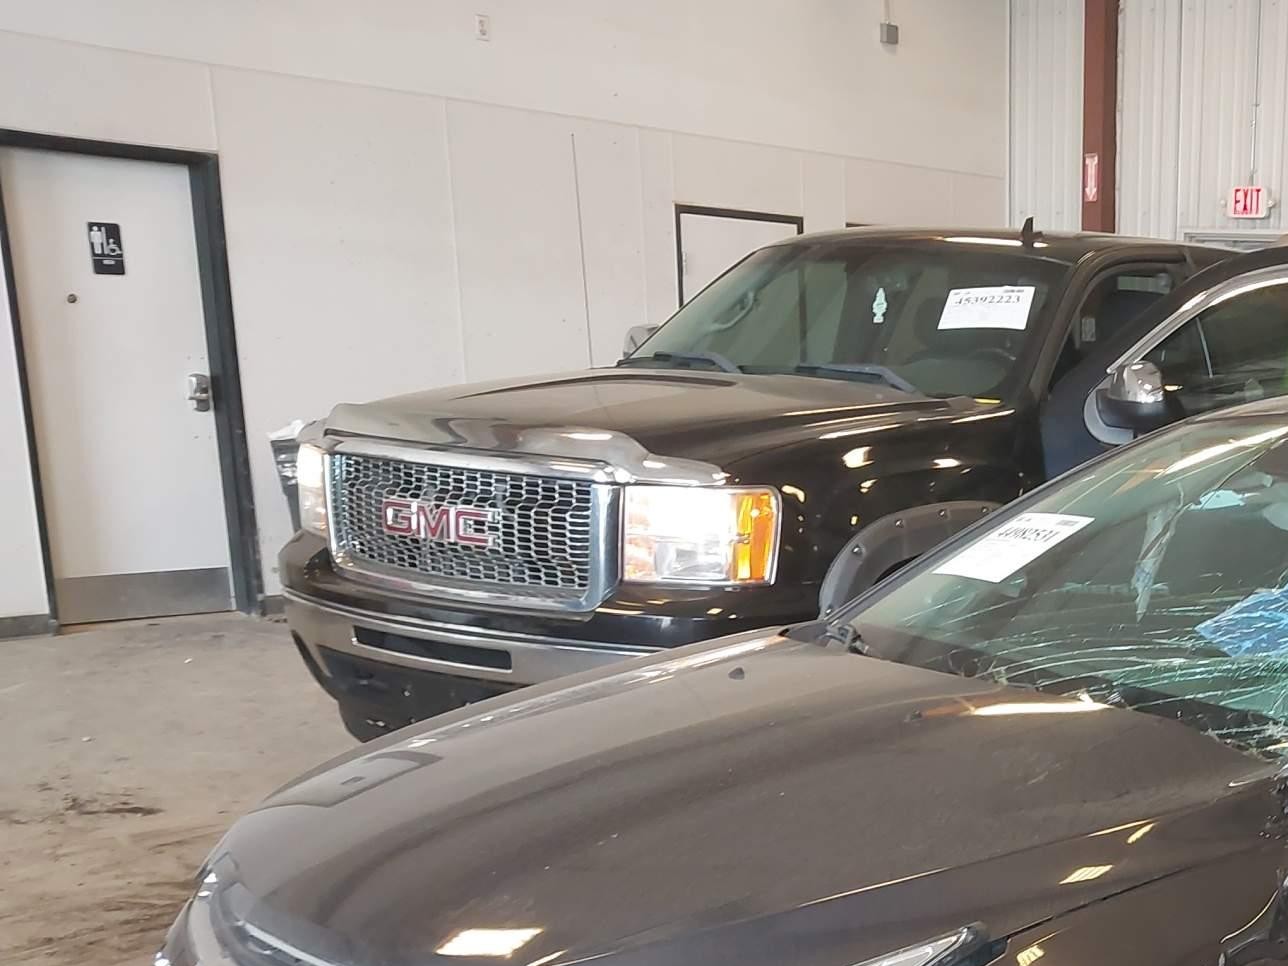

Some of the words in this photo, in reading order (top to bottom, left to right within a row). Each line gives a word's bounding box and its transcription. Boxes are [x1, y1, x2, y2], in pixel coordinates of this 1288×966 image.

[1233, 187, 1262, 215] EXIT
[954, 295, 1021, 305] 45392223
[382, 499, 498, 548] GMC
